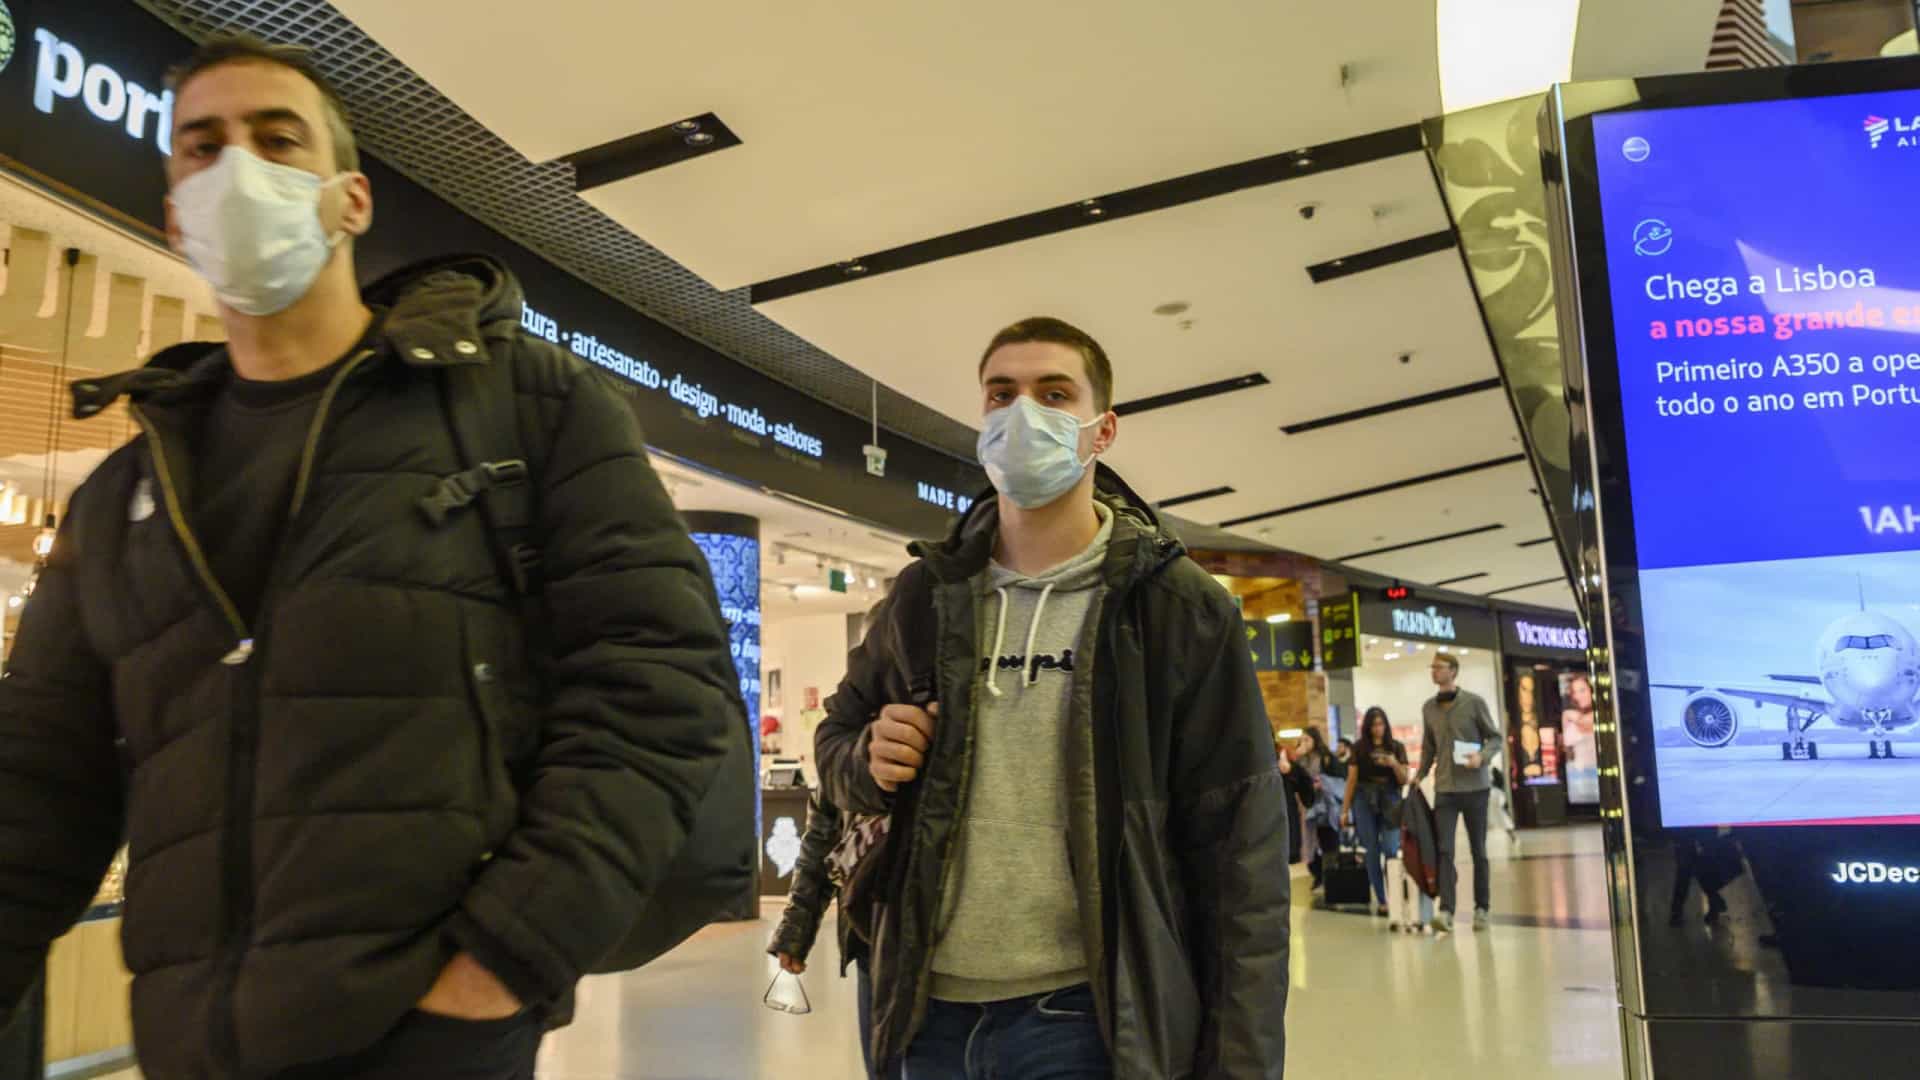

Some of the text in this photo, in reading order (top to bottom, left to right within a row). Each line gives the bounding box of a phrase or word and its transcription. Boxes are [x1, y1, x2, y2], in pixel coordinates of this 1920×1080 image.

[1645, 264, 1876, 304] Chega a Lisboa
[1650, 321, 1668, 339] a
[1675, 314, 1765, 338] nossa
[1773, 301, 1885, 340] grande
[1656, 352, 1920, 383] Primeiro A350 a ope
[571, 332, 660, 389] artesanato
[670, 374, 718, 417] design
[728, 403, 766, 435] moda
[775, 423, 822, 457] sabores
[1656, 391, 1715, 416] todo
[1724, 396, 1739, 413] o
[1748, 393, 1794, 412] ano
[1803, 390, 1844, 408] em
[917, 481, 955, 510] MADE
[1831, 861, 1920, 883] JCDec
